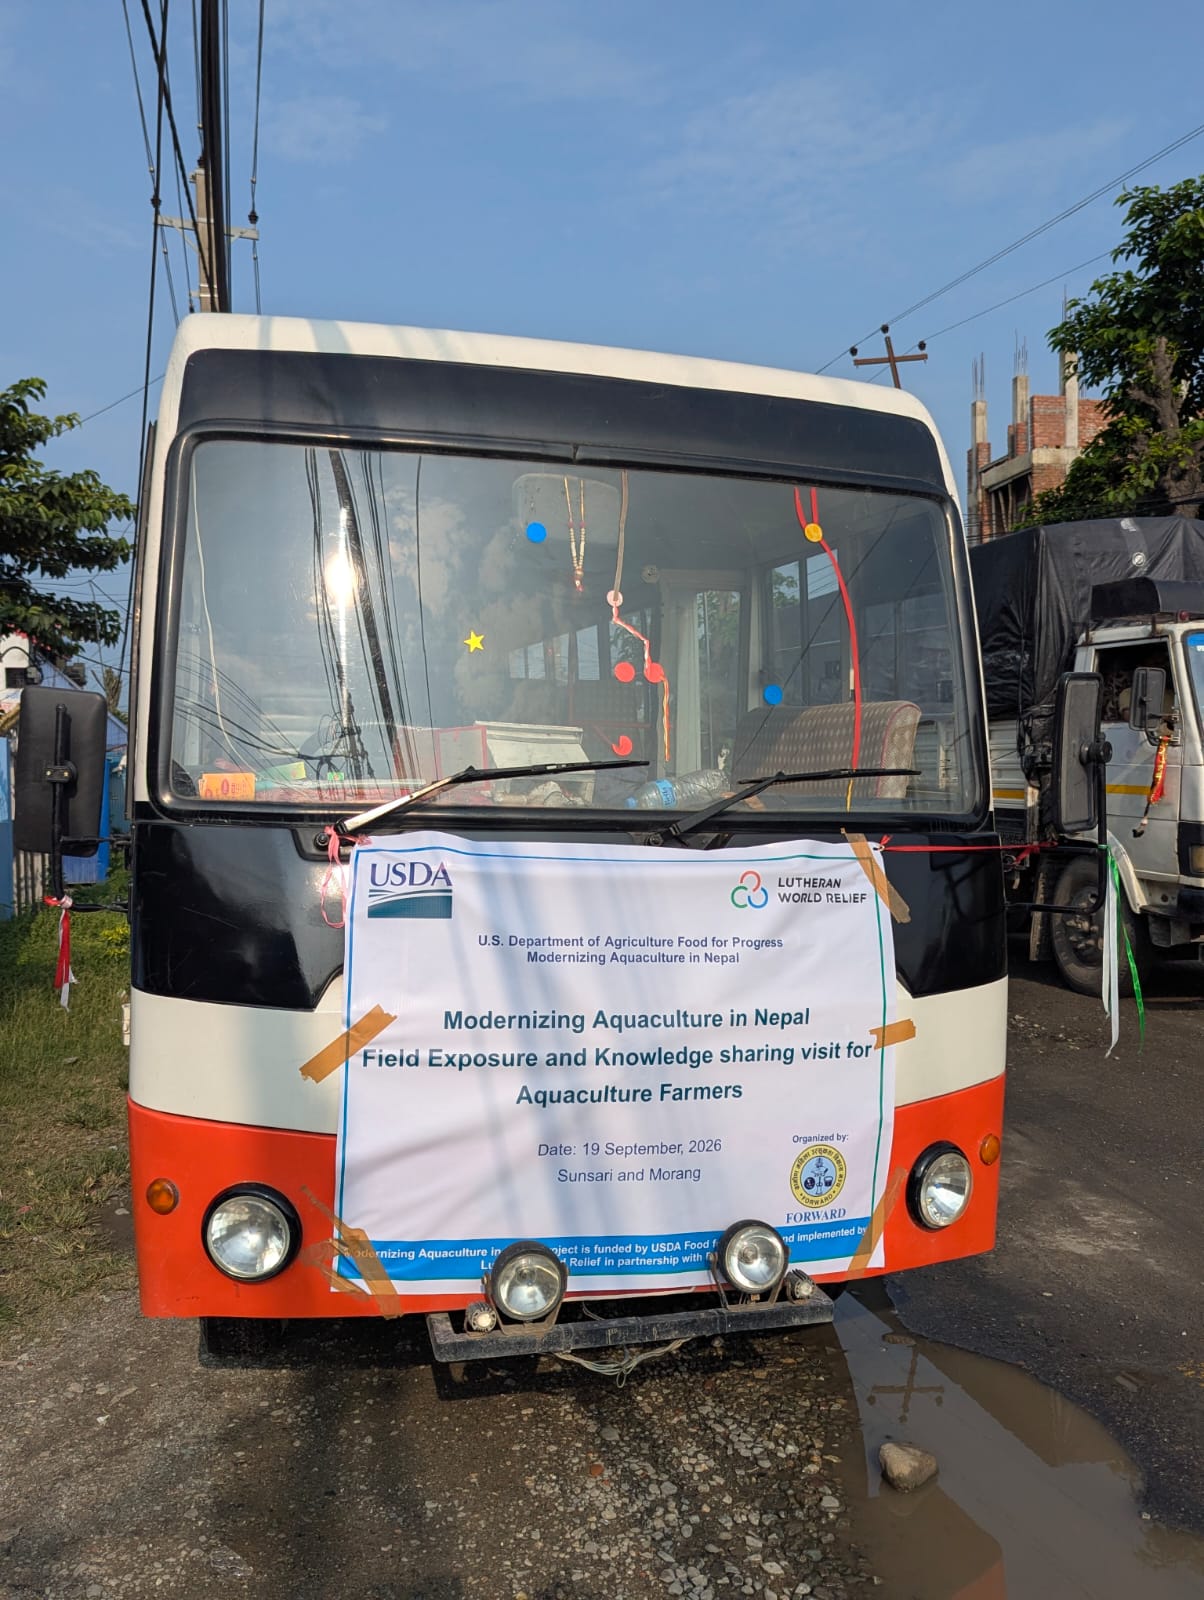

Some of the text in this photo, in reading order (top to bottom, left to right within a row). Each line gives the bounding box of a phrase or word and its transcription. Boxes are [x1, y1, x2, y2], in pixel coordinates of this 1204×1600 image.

[370, 861, 453, 887] USDA
[778, 877, 842, 889] LUTHERAN
[778, 892, 867, 904] WORLD RELIEF
[478, 935, 783, 951] U.S. Department of Agriculture Food for Progress
[527, 951, 740, 965] Modernizing Aquaculture in Nepal
[443, 1008, 810, 1033] Modernizing Aquaculture in Nepal
[362, 1041, 872, 1071] Field Exposure and Knowledge sharing visit for
[516, 1083, 743, 1108] Aquaculture Farmers
[792, 1133, 849, 1144] Organized by:
[538, 1139, 722, 1158] Date: 19 September, 2026
[557, 1167, 702, 1183] Sunsari and Morang
[801, 1193, 833, 1206] FORWARD
[786, 1207, 847, 1223] FORWARD
[418, 1248, 487, 1260] Aquaculture
[490, 1247, 501, 1257] in
[581, 1245, 591, 1254] is
[594, 1244, 632, 1254] funded
[635, 1244, 648, 1256] by
[651, 1241, 681, 1253] USDA
[684, 1240, 710, 1251] Food
[782, 1233, 795, 1243] nd
[797, 1226, 855, 1243] implemented
[570, 1257, 601, 1267] Relief
[604, 1256, 615, 1267] in
[617, 1254, 679, 1269] partnership
[681, 1252, 703, 1264] with
